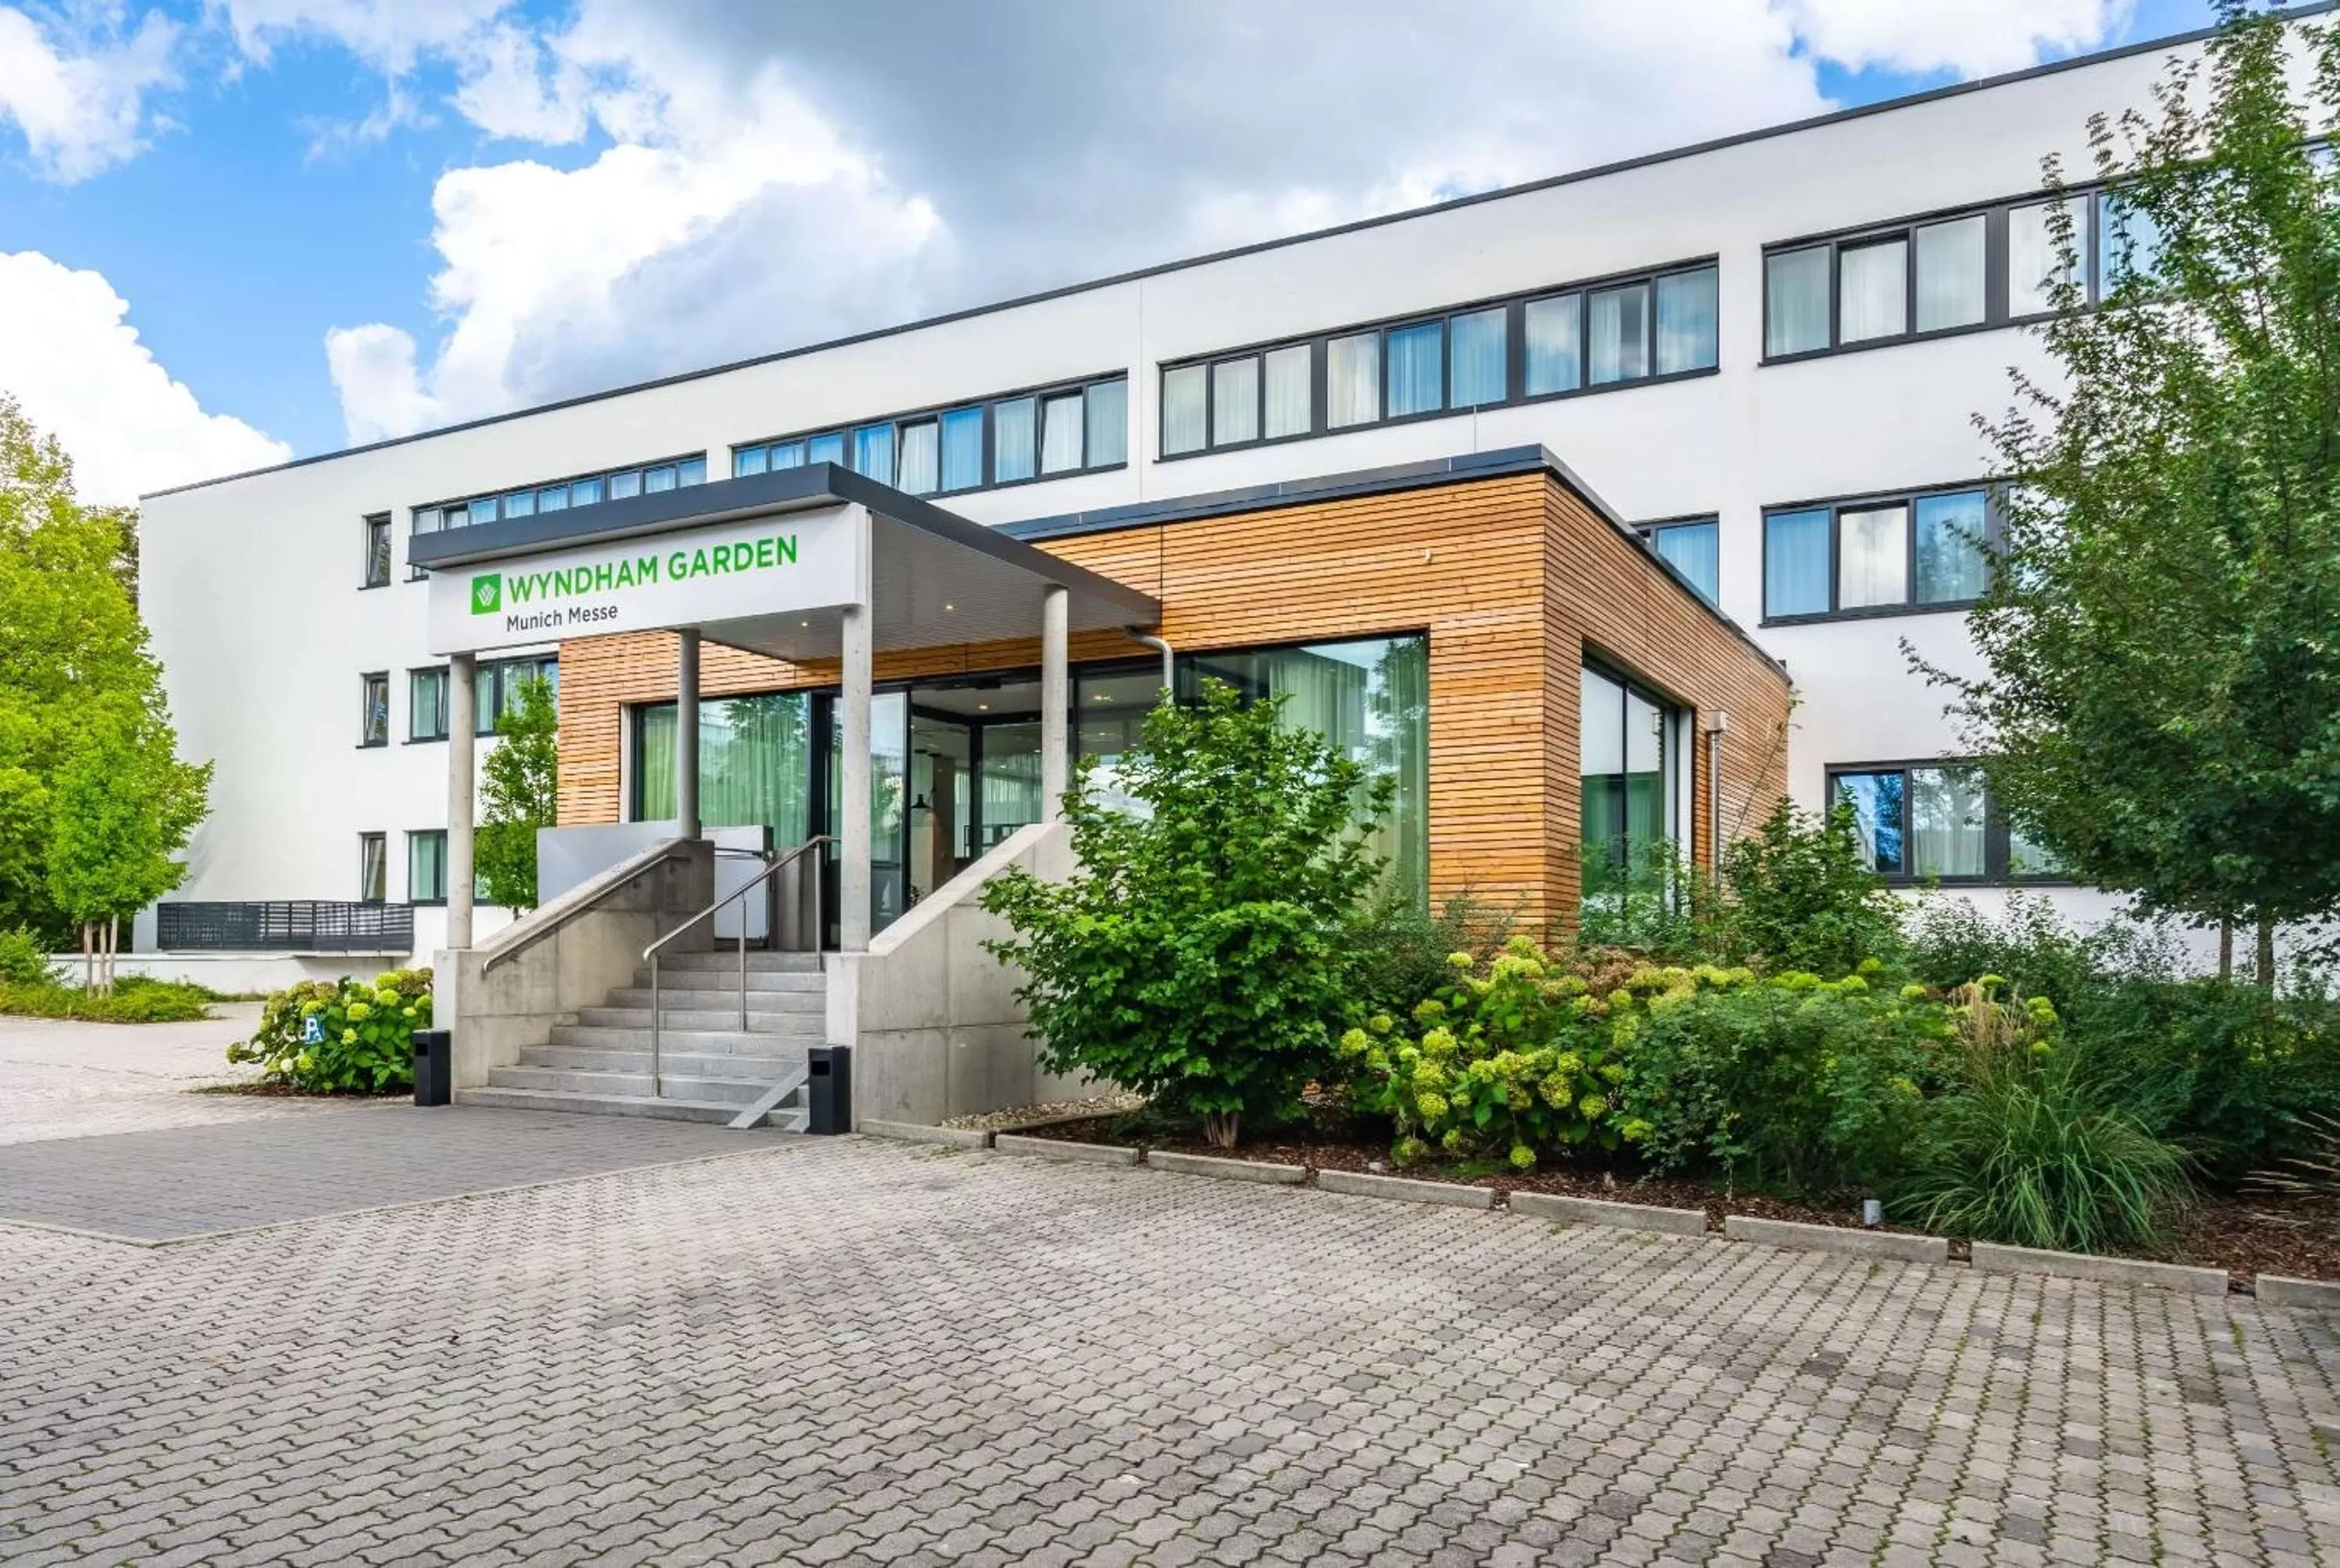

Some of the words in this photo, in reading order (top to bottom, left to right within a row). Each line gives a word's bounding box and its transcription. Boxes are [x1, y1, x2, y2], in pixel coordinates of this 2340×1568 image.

[508, 555, 657, 603] WYNDHAM
[668, 535, 797, 580] GARDEN
[507, 610, 562, 631] Munich
[569, 605, 618, 624] Messe
